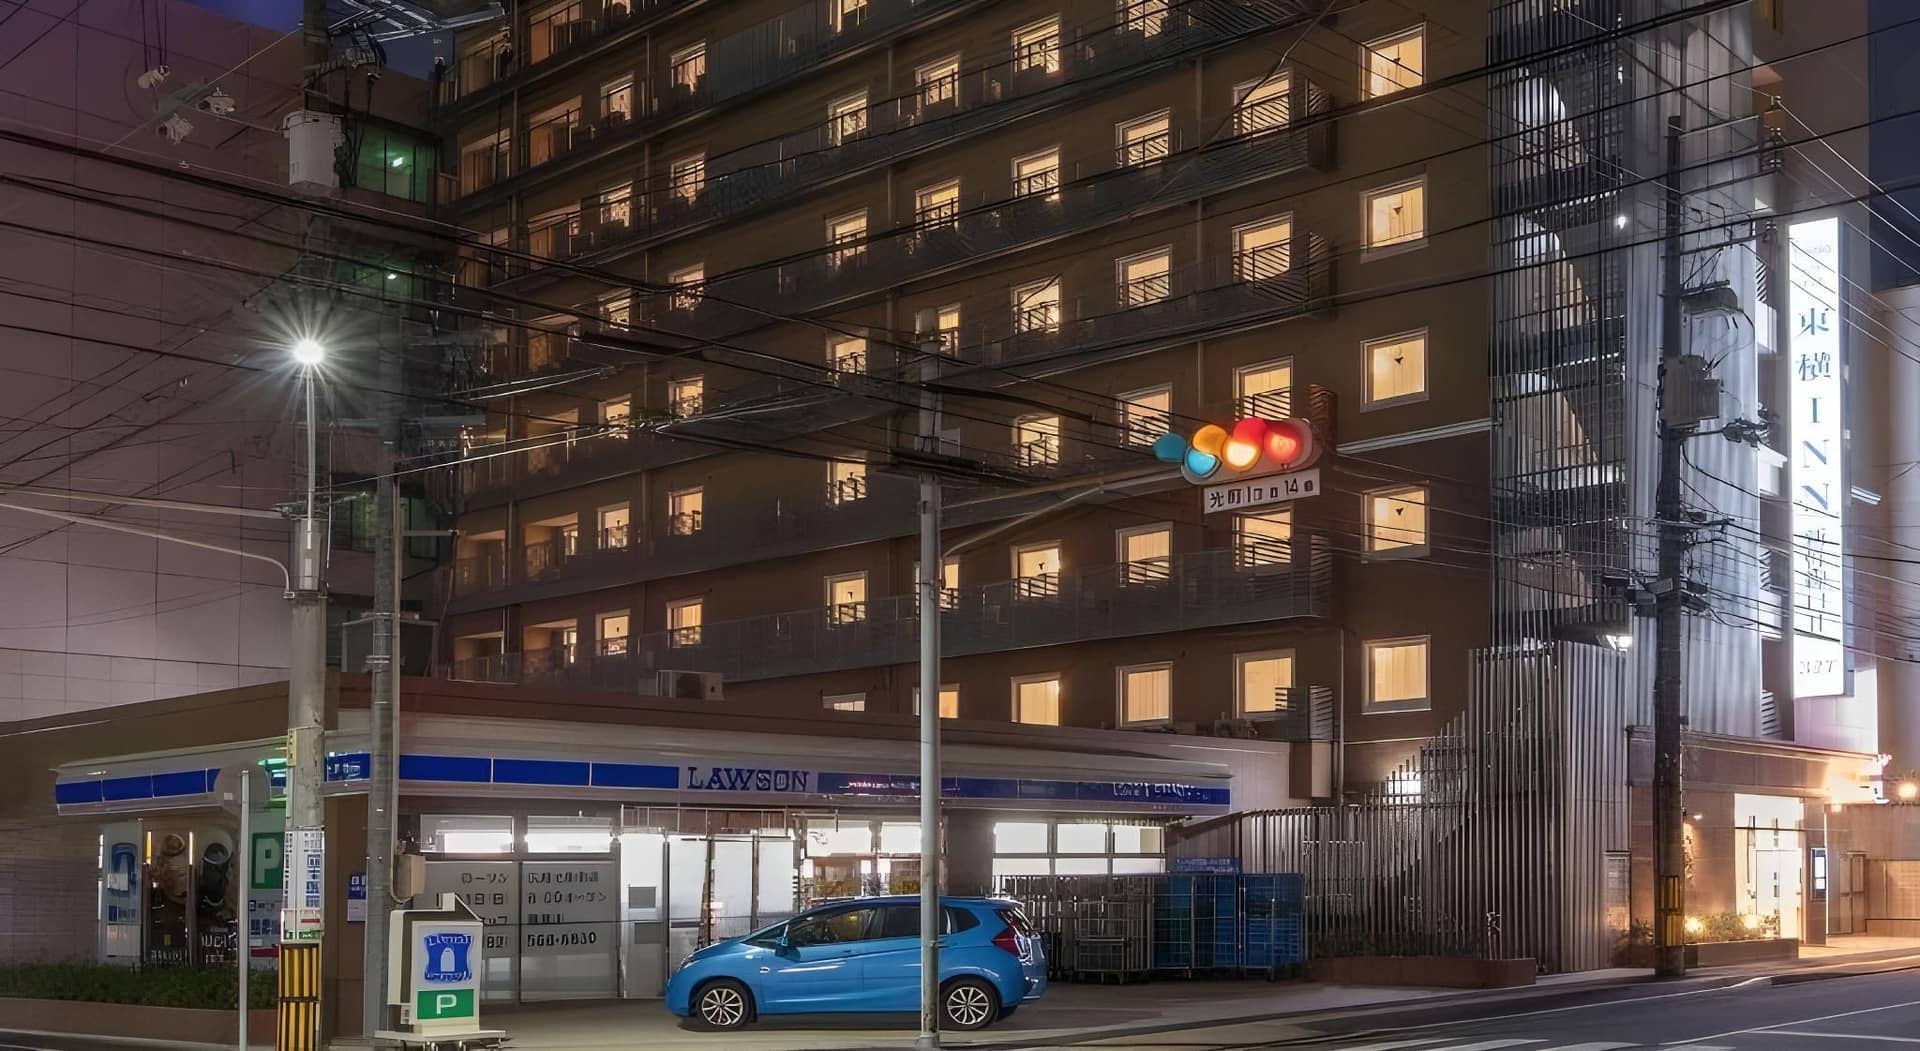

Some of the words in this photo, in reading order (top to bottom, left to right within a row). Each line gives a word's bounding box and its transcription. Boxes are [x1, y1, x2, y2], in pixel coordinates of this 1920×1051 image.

[687, 766, 810, 792] LAWSON
[254, 837, 281, 885] P
[436, 993, 457, 1014] P
